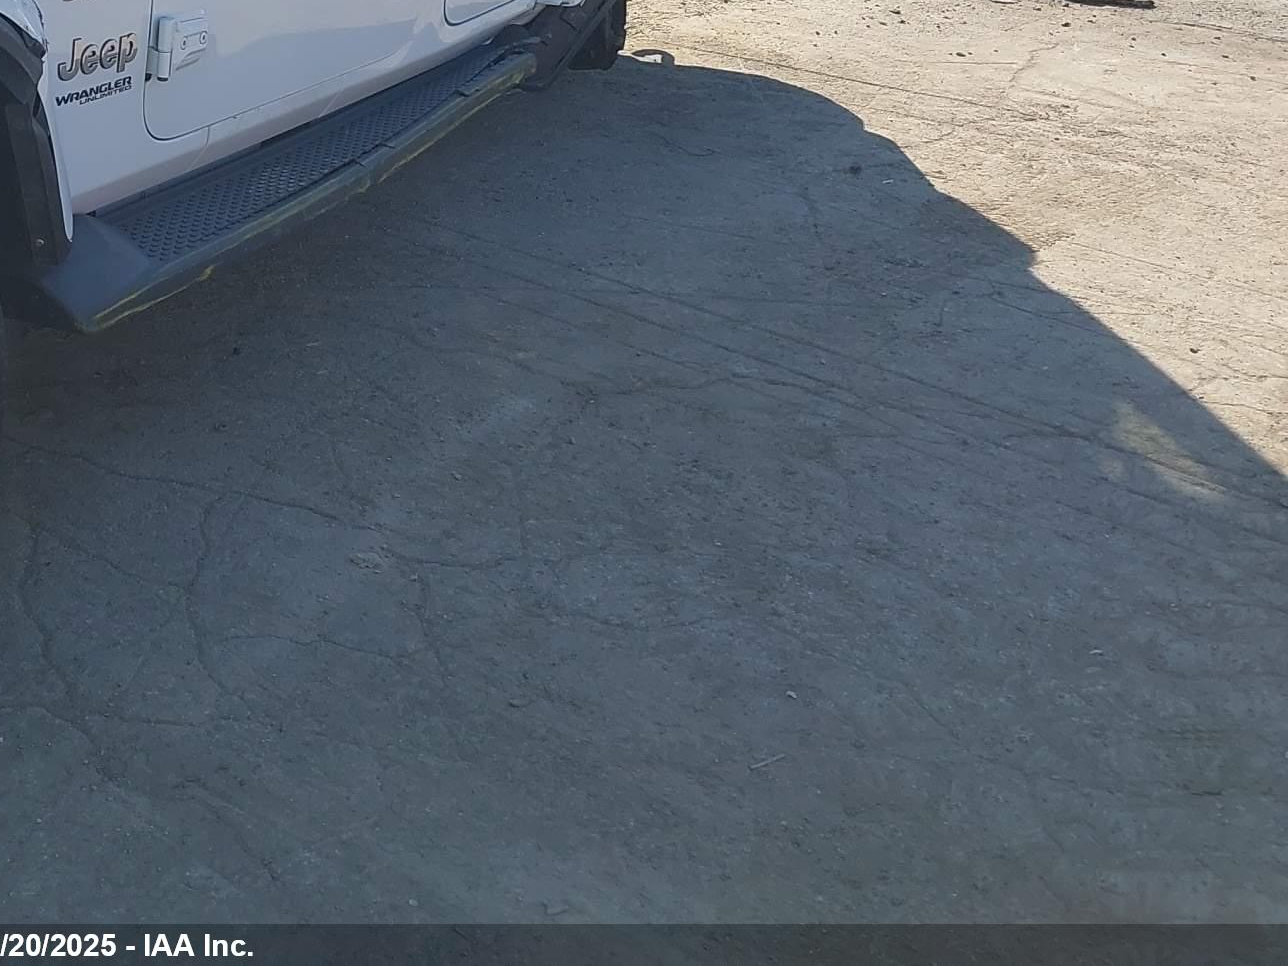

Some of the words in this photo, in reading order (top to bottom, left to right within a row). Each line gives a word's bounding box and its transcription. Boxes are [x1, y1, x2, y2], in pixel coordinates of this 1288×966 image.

[57, 33, 138, 81] Jeep
[56, 76, 132, 106] WRANGLER
[80, 85, 132, 105] UNLIMITED
